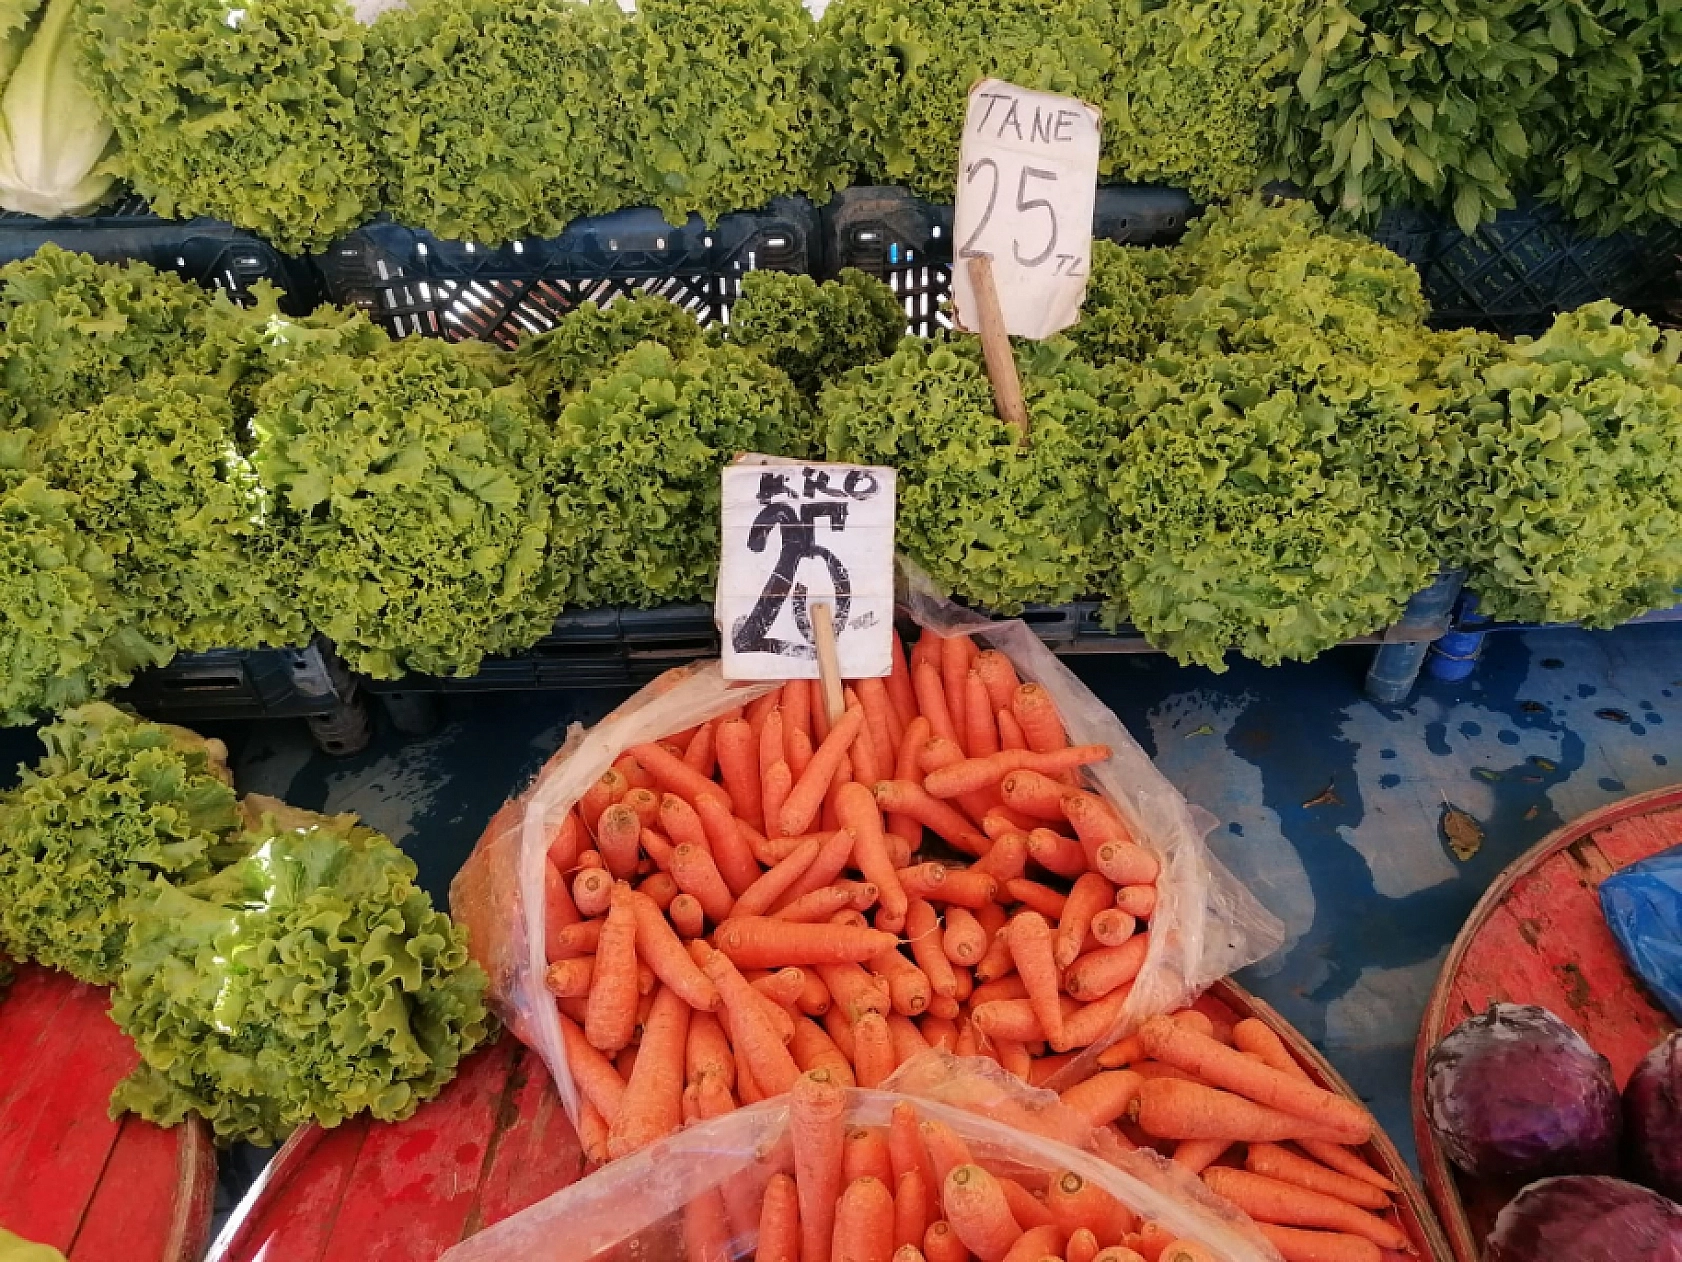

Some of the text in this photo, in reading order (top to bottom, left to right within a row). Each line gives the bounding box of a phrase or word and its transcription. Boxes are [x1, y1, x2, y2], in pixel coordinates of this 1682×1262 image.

[977, 92, 1081, 144] TANE
[959, 157, 1085, 277] 25 TL
[732, 501, 852, 660] 25
